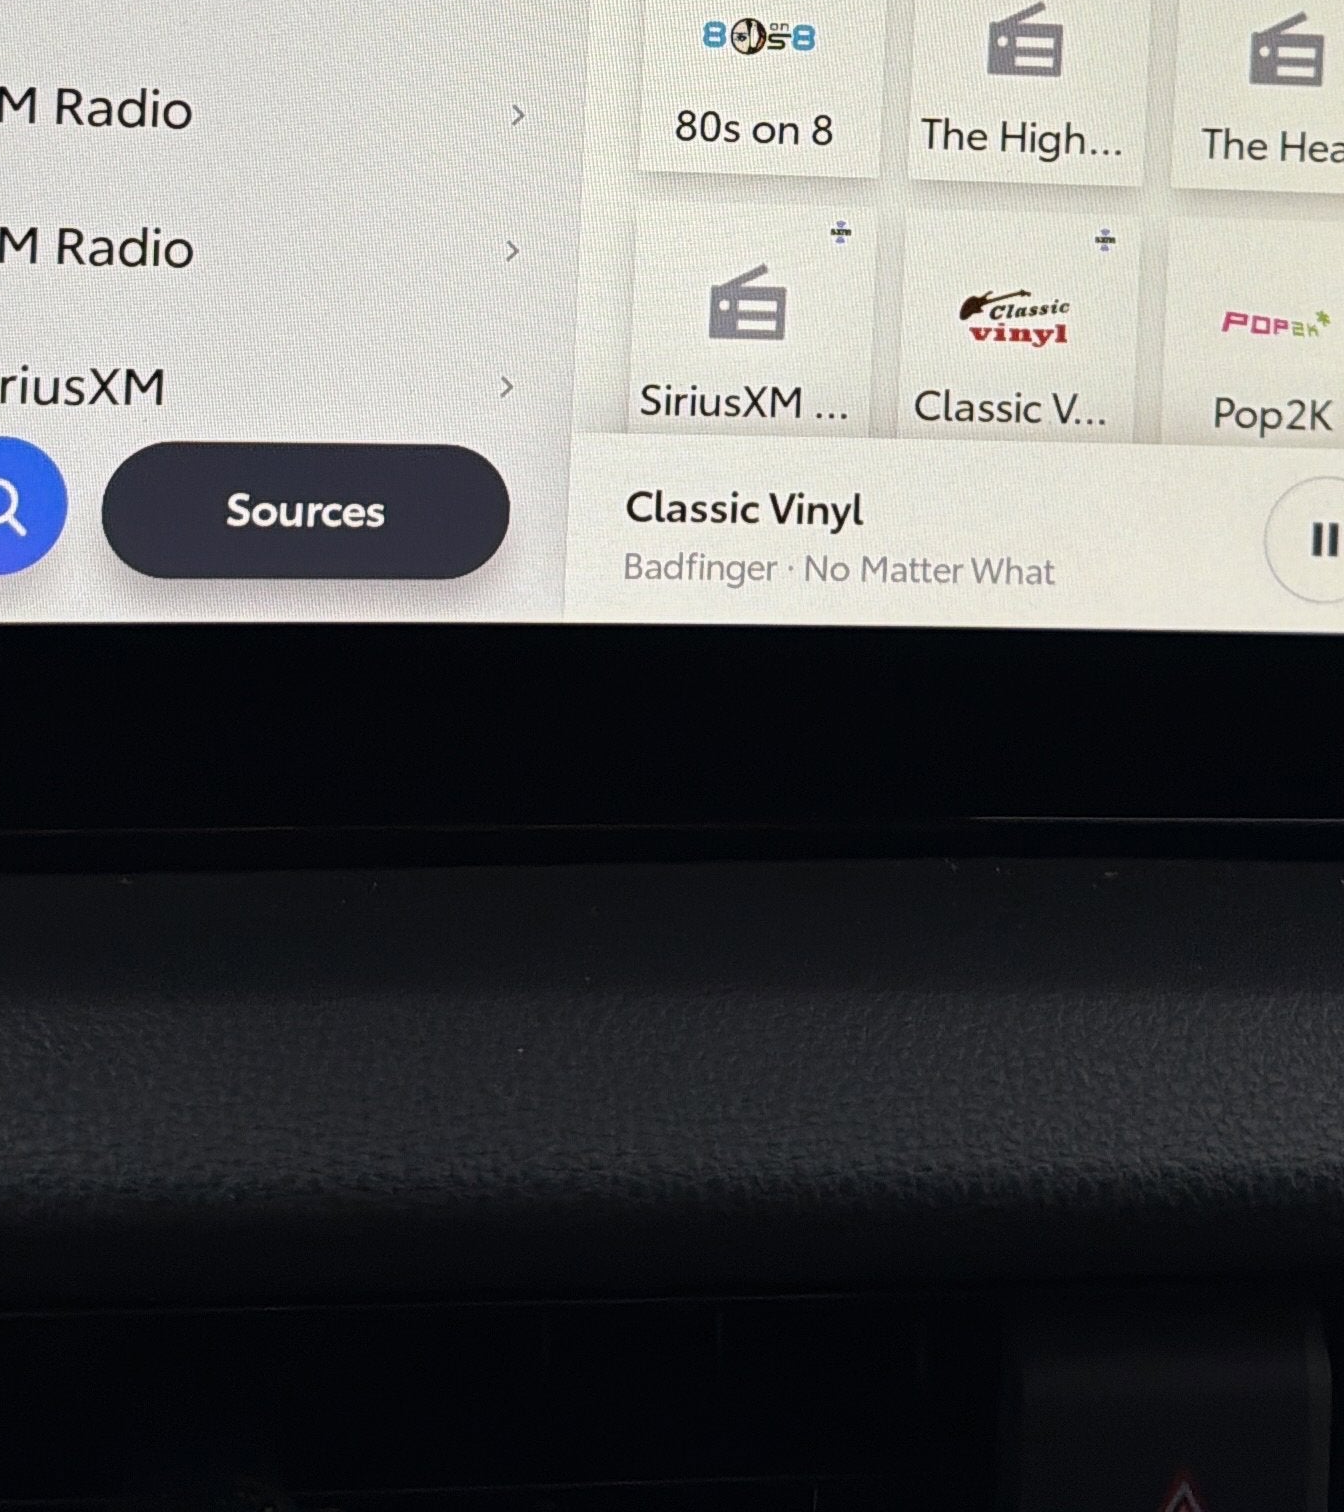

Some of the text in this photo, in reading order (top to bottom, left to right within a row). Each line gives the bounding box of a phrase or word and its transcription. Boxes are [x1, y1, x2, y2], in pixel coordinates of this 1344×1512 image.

[790, 24, 817, 52] 8
[56, 87, 192, 130] Radio
[675, 109, 833, 146] 80s on 8
[921, 117, 988, 151] The
[1202, 127, 1268, 161] The
[57, 226, 194, 269] Radio
[988, 296, 1069, 321] Classic
[640, 384, 802, 419] SiriusXM
[914, 389, 1042, 424] Classic
[1214, 397, 1332, 439] Pop2K
[226, 492, 385, 528] Sources
[626, 489, 864, 535] Classic Vinyl
[624, 551, 778, 590] Badfinger
[805, 554, 851, 582] No
[861, 555, 964, 584] Matter
[971, 556, 1055, 586] What
